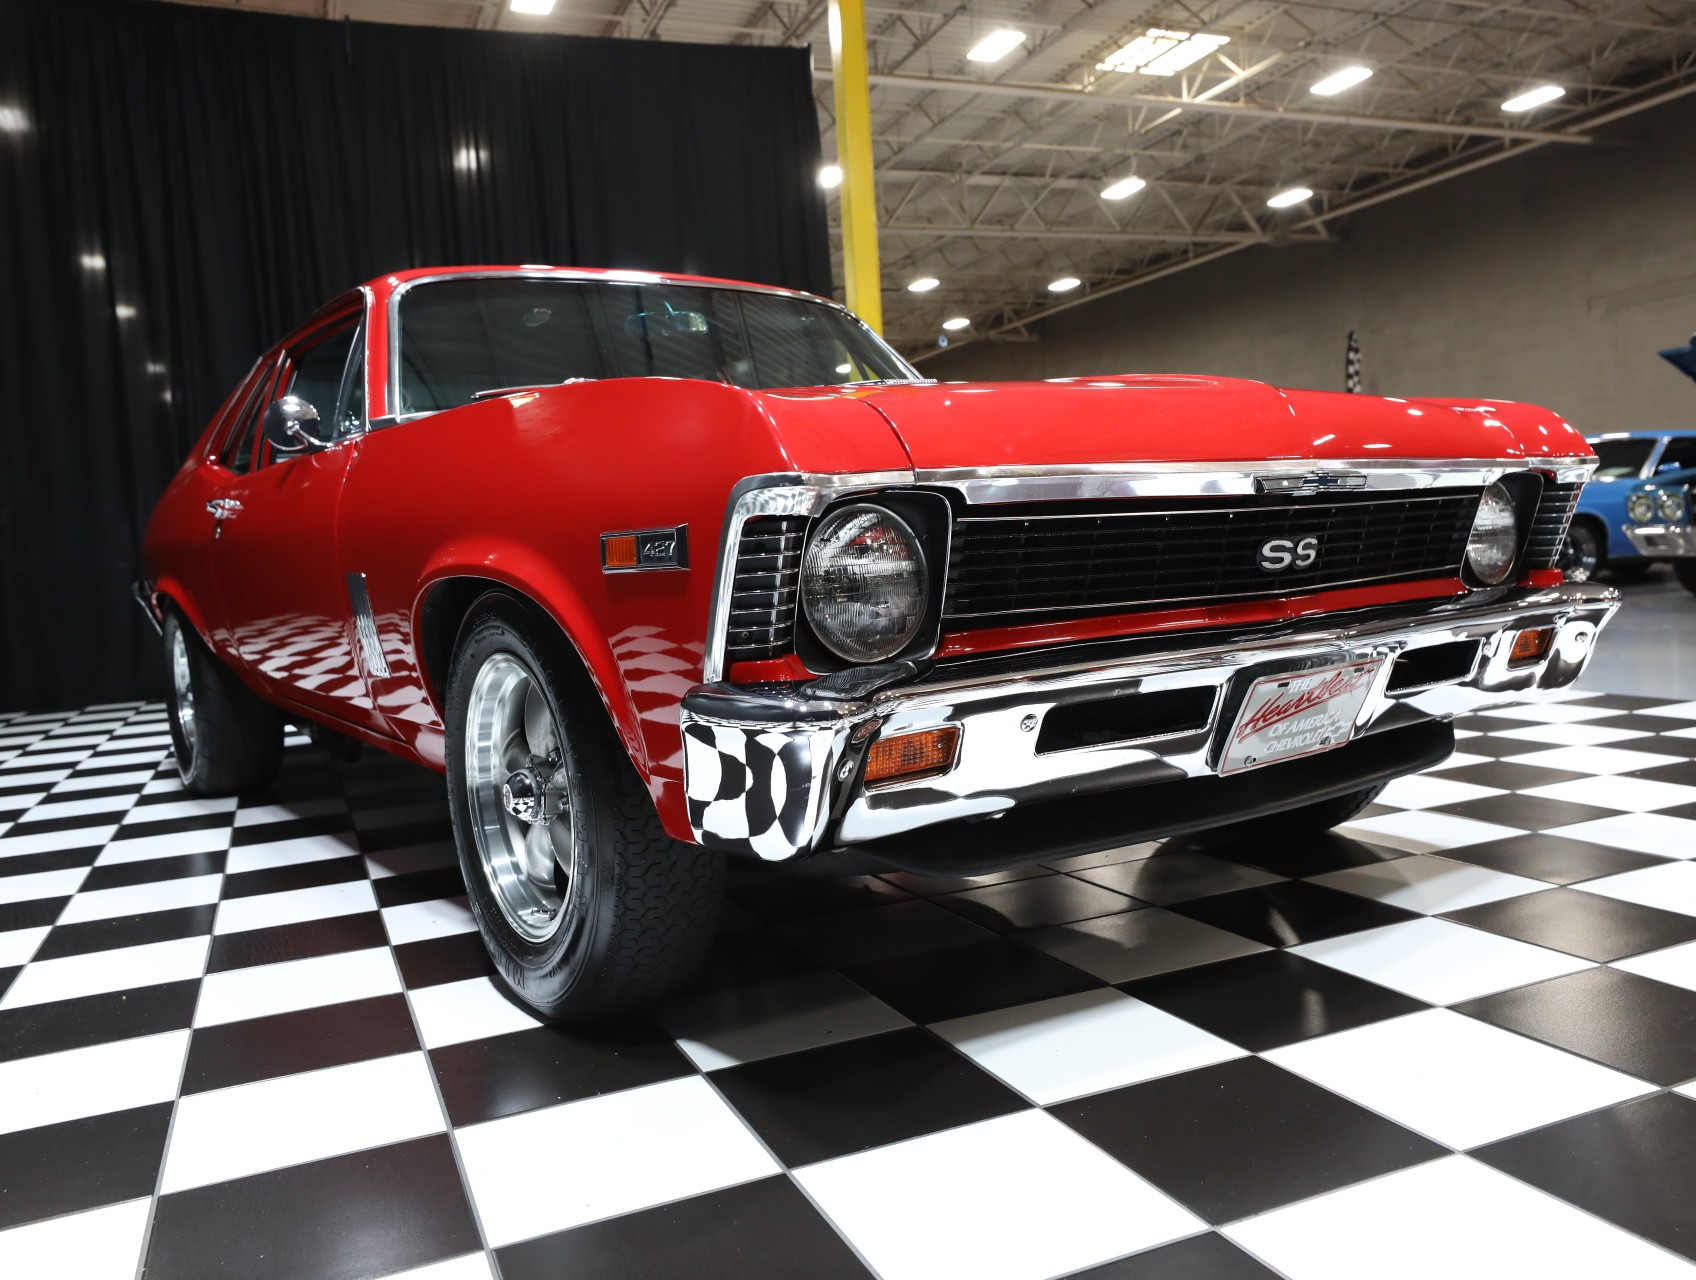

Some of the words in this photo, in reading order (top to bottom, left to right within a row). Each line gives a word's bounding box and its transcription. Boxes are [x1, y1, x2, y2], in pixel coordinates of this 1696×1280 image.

[643, 540, 676, 557] 427
[1259, 537, 1318, 570] SS
[1288, 678, 1313, 694] THE
[1267, 721, 1290, 738] OF
[1287, 710, 1342, 733] AMERICA
[1263, 731, 1326, 754] CHEVROLET
